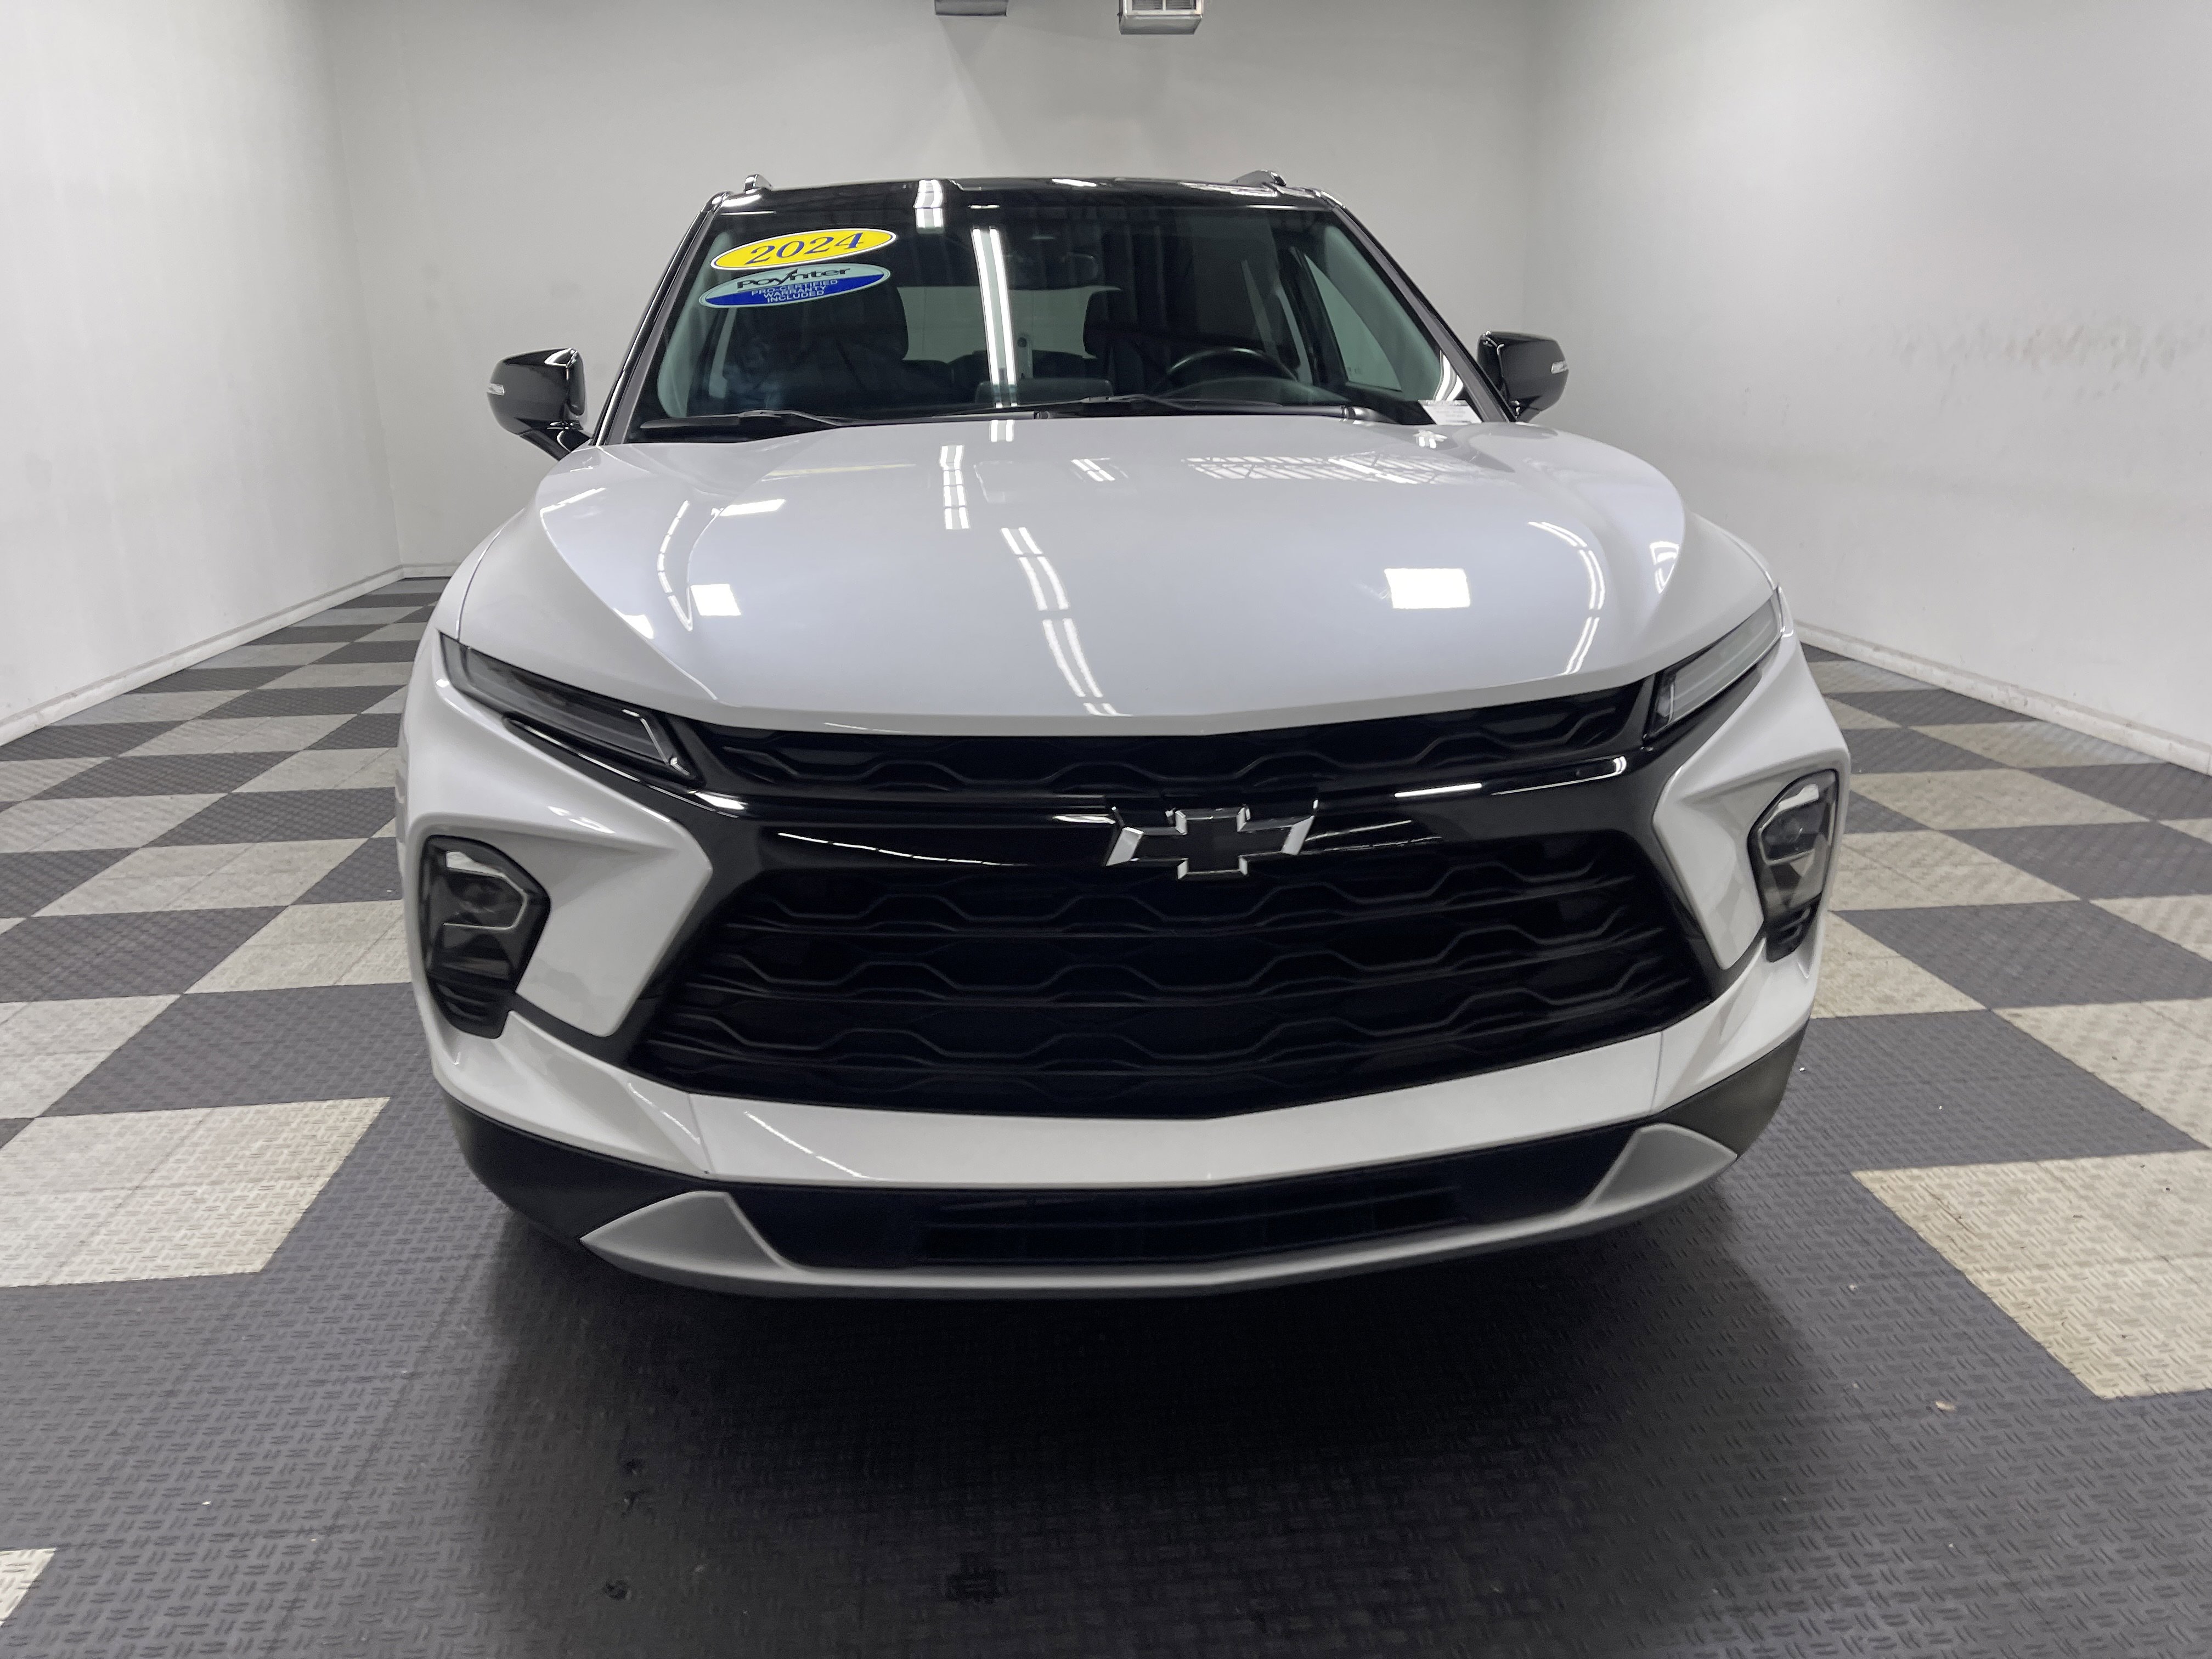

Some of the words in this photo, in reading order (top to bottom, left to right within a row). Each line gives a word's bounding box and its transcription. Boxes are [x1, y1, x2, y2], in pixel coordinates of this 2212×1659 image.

[743, 232, 864, 265] 2024
[751, 279, 838, 296] PRO-CERTIFIED
[763, 285, 827, 298] WARRANTY
[767, 290, 825, 303] INCLUDED
